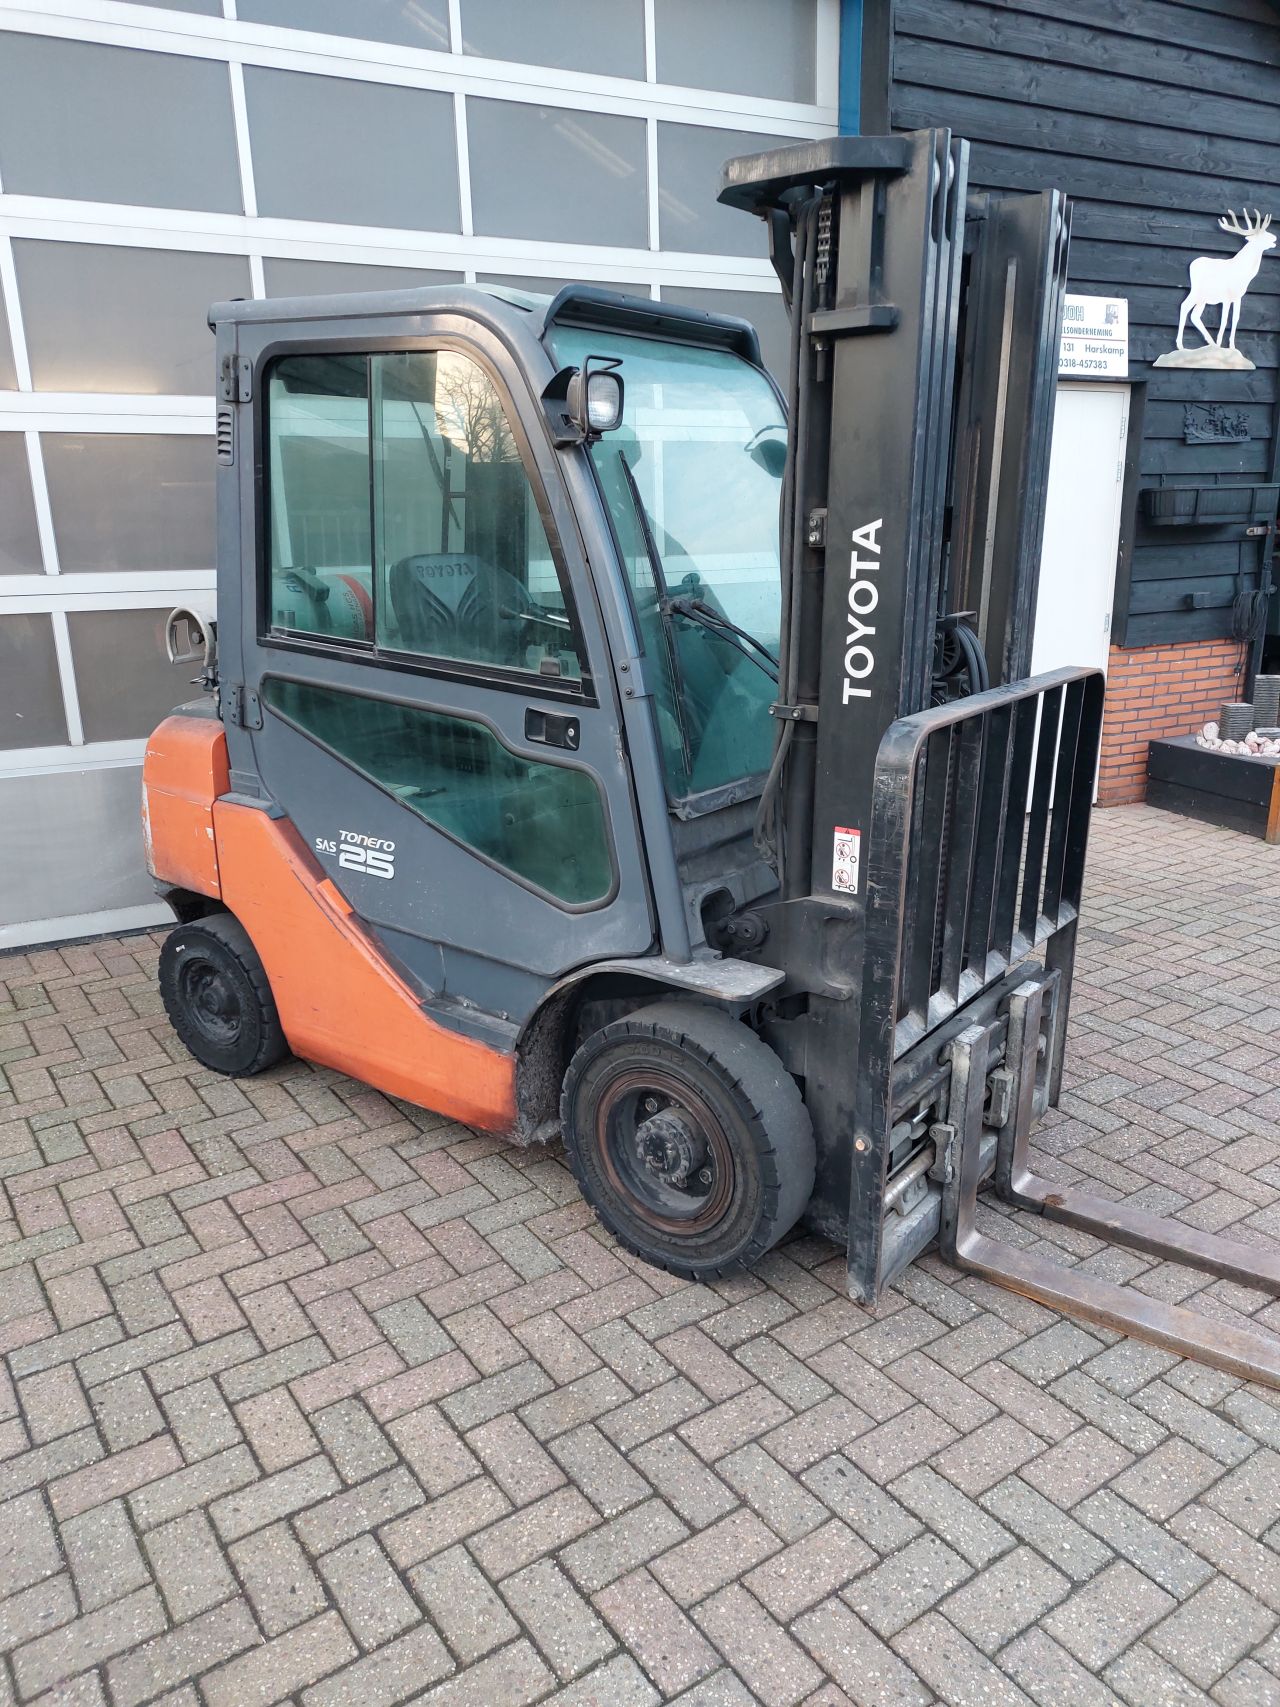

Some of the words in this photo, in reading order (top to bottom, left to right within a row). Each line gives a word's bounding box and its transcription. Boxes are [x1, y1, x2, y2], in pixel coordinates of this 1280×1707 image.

[1061, 326, 1113, 337] LSONDERNEMING
[1063, 343, 1075, 352] 131
[1085, 344, 1125, 357] Harskamp
[416, 562, 475, 578] TOYOTA
[842, 518, 883, 705] TOYOTA
[315, 838, 337, 853] SAS
[339, 830, 396, 852] TONERO
[338, 843, 395, 880] 25
